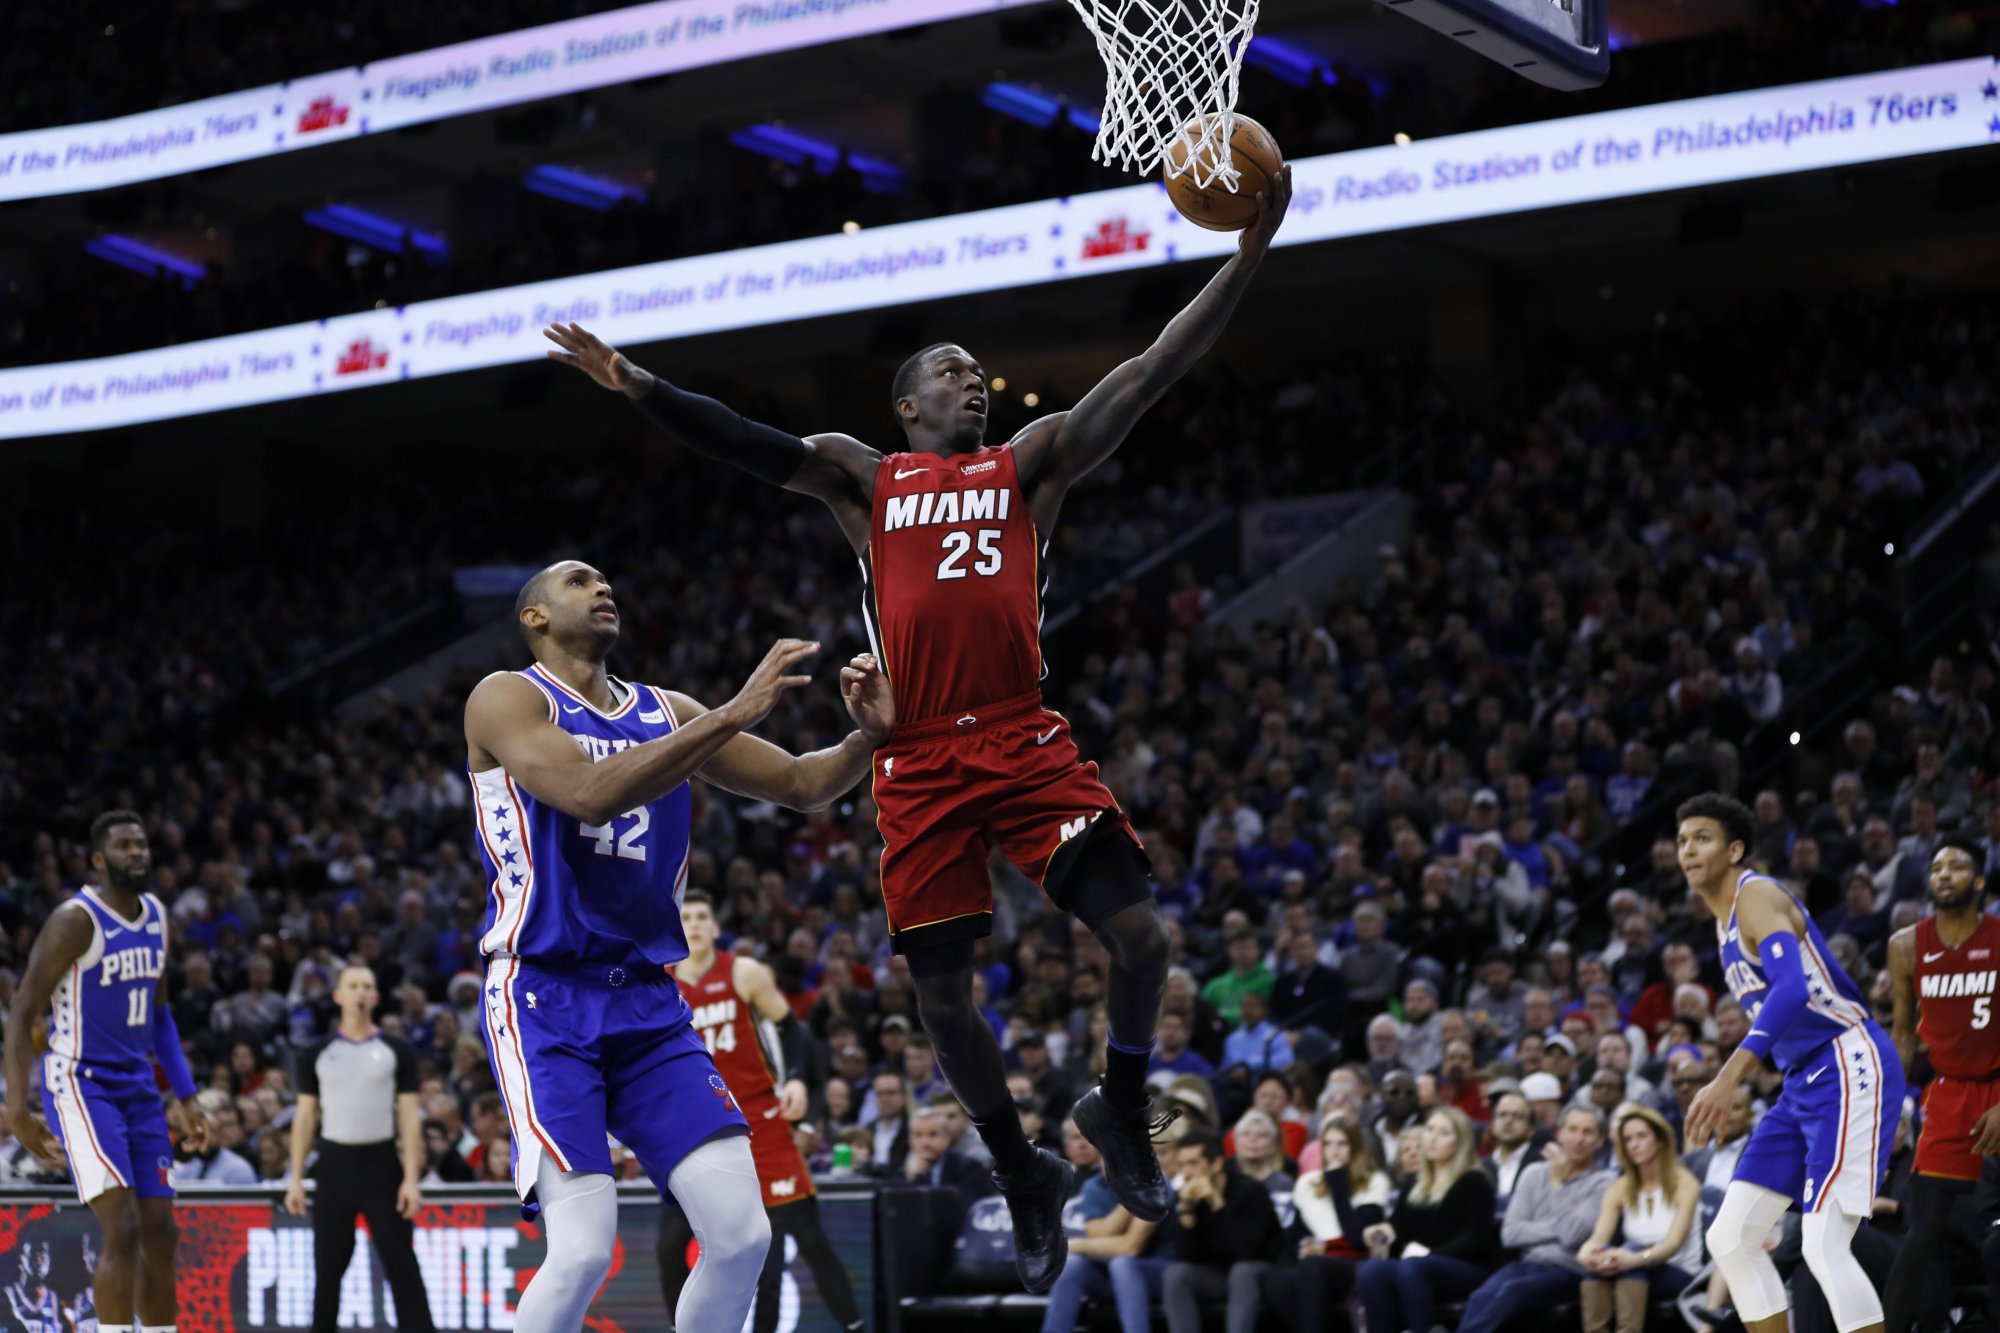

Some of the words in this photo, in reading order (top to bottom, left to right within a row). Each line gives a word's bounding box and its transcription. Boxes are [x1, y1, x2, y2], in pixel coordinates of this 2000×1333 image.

[382, 62, 480, 100] Flagship
[486, 47, 554, 79] Radio
[563, 27, 648, 67] Station
[654, 19, 682, 47] of
[687, 13, 724, 38] the
[22, 150, 56, 174] the
[64, 126, 195, 169] Philadelphia
[203, 111, 258, 141] 76ers
[1332, 173, 1421, 204] Radio
[1432, 152, 1541, 191] Station
[1551, 139, 1585, 173] of
[1592, 133, 1642, 168] the
[1652, 102, 1856, 157] Philadelphia
[1866, 92, 1958, 128] 76ers
[424, 312, 523, 346] Flagship
[531, 301, 600, 327] Radio
[610, 284, 696, 318] Station
[702, 276, 729, 301] of
[736, 268, 774, 297] the
[783, 242, 945, 288] Philadelphia
[957, 232, 1029, 263] 76ers
[30, 384, 57, 409] of
[61, 380, 95, 406] the
[103, 360, 230, 399] Philadelphia
[239, 351, 295, 378] 76ers
[884, 488, 1010, 532] MIAMI
[936, 529, 1002, 580] 25
[127, 987, 149, 1027] 11
[1921, 970, 1997, 998] MIAMI
[703, 1023, 737, 1056] 14
[1970, 997, 1992, 1030] 5
[248, 1227, 375, 1327] PHIA
